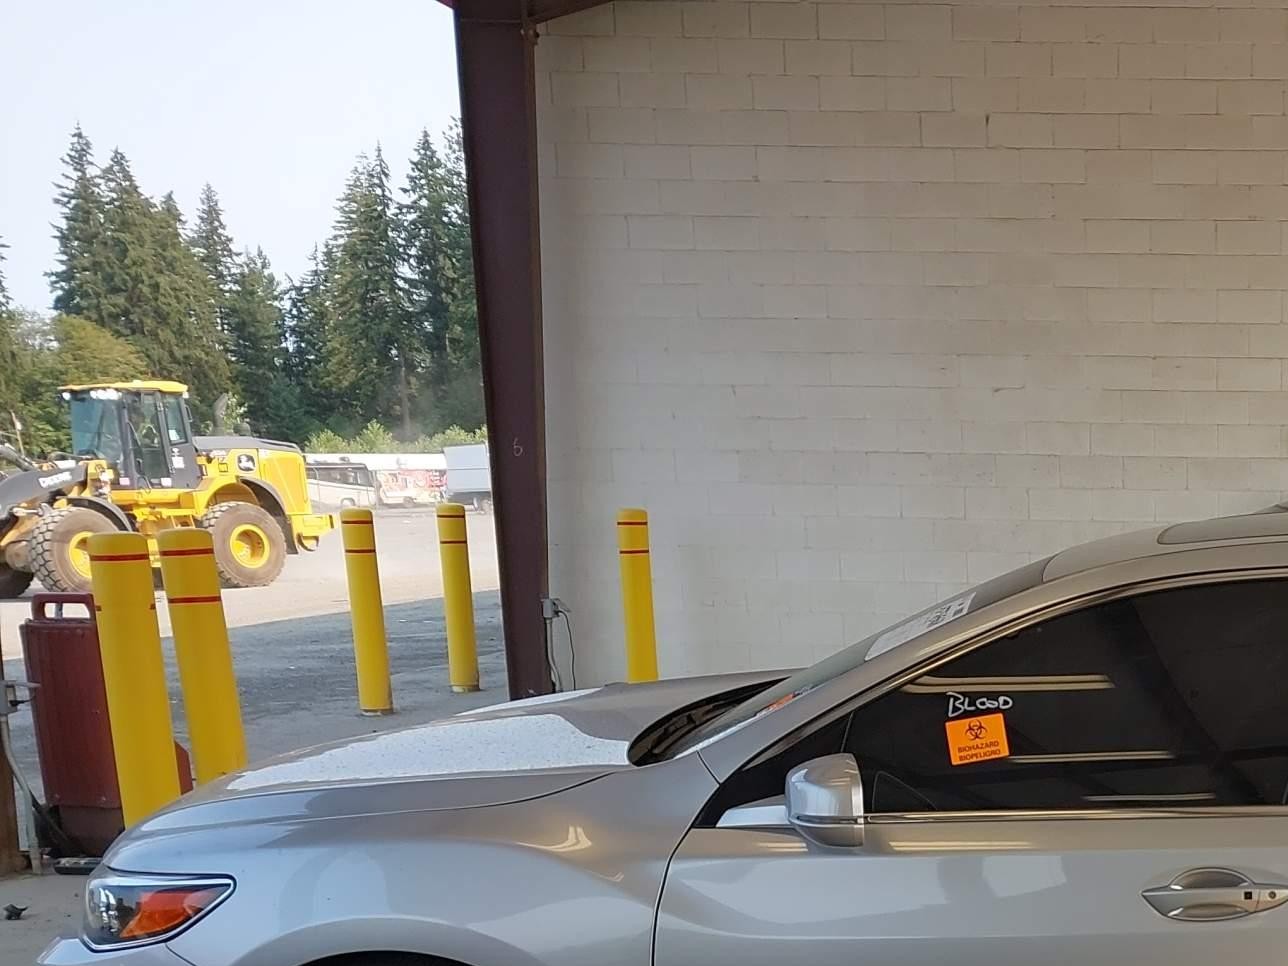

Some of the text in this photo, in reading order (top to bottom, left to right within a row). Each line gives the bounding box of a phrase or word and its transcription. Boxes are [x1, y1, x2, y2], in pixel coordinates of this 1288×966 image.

[946, 691, 1013, 718] BLOOD
[957, 740, 1000, 753] BIOHAZARD
[958, 748, 1001, 762] BIOPELIGRO
